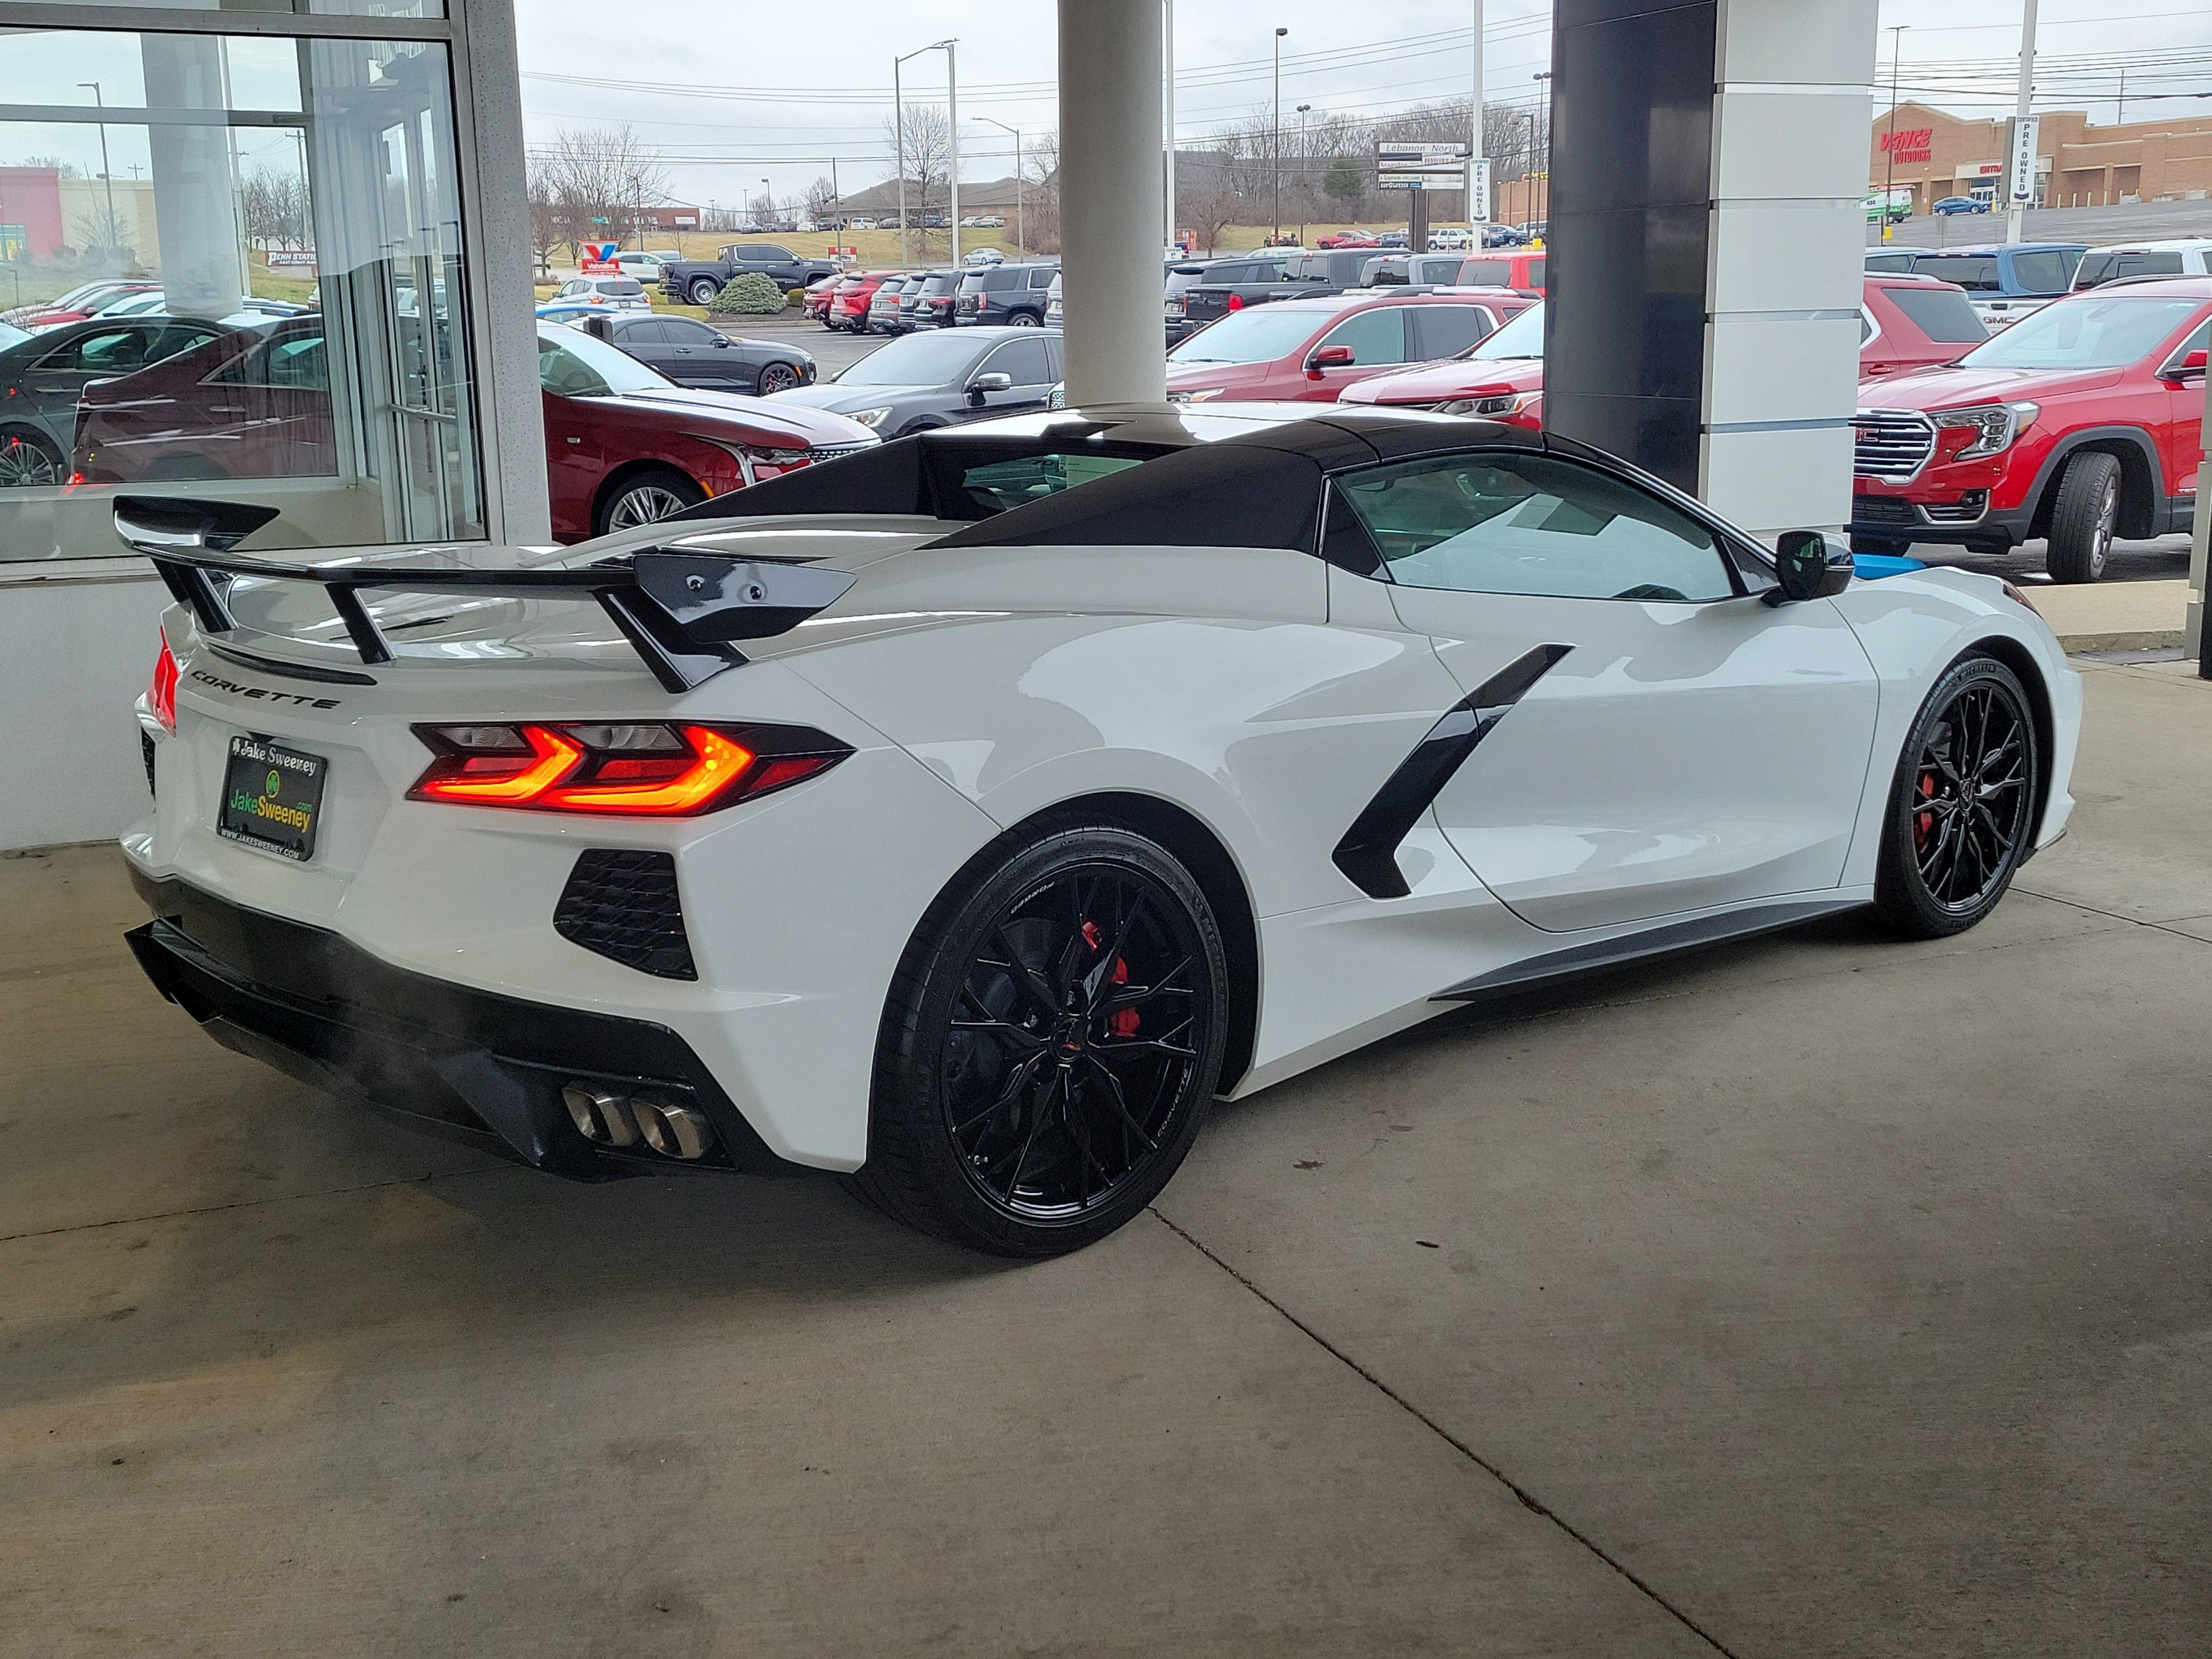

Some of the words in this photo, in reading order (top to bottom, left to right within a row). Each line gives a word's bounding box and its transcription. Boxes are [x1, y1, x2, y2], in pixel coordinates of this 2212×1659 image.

[1386, 144, 1425, 152] Lebanon
[1431, 144, 1458, 153] North
[1894, 149, 1931, 164] OUTDOORS
[2019, 151, 2028, 191] OWNED
[268, 252, 291, 266] PENN
[191, 670, 341, 709] CORVETTE
[241, 741, 266, 760] Jake
[268, 747, 317, 777] Sweeney
[221, 827, 300, 859] WWW.JAKESWEENEY.COM
